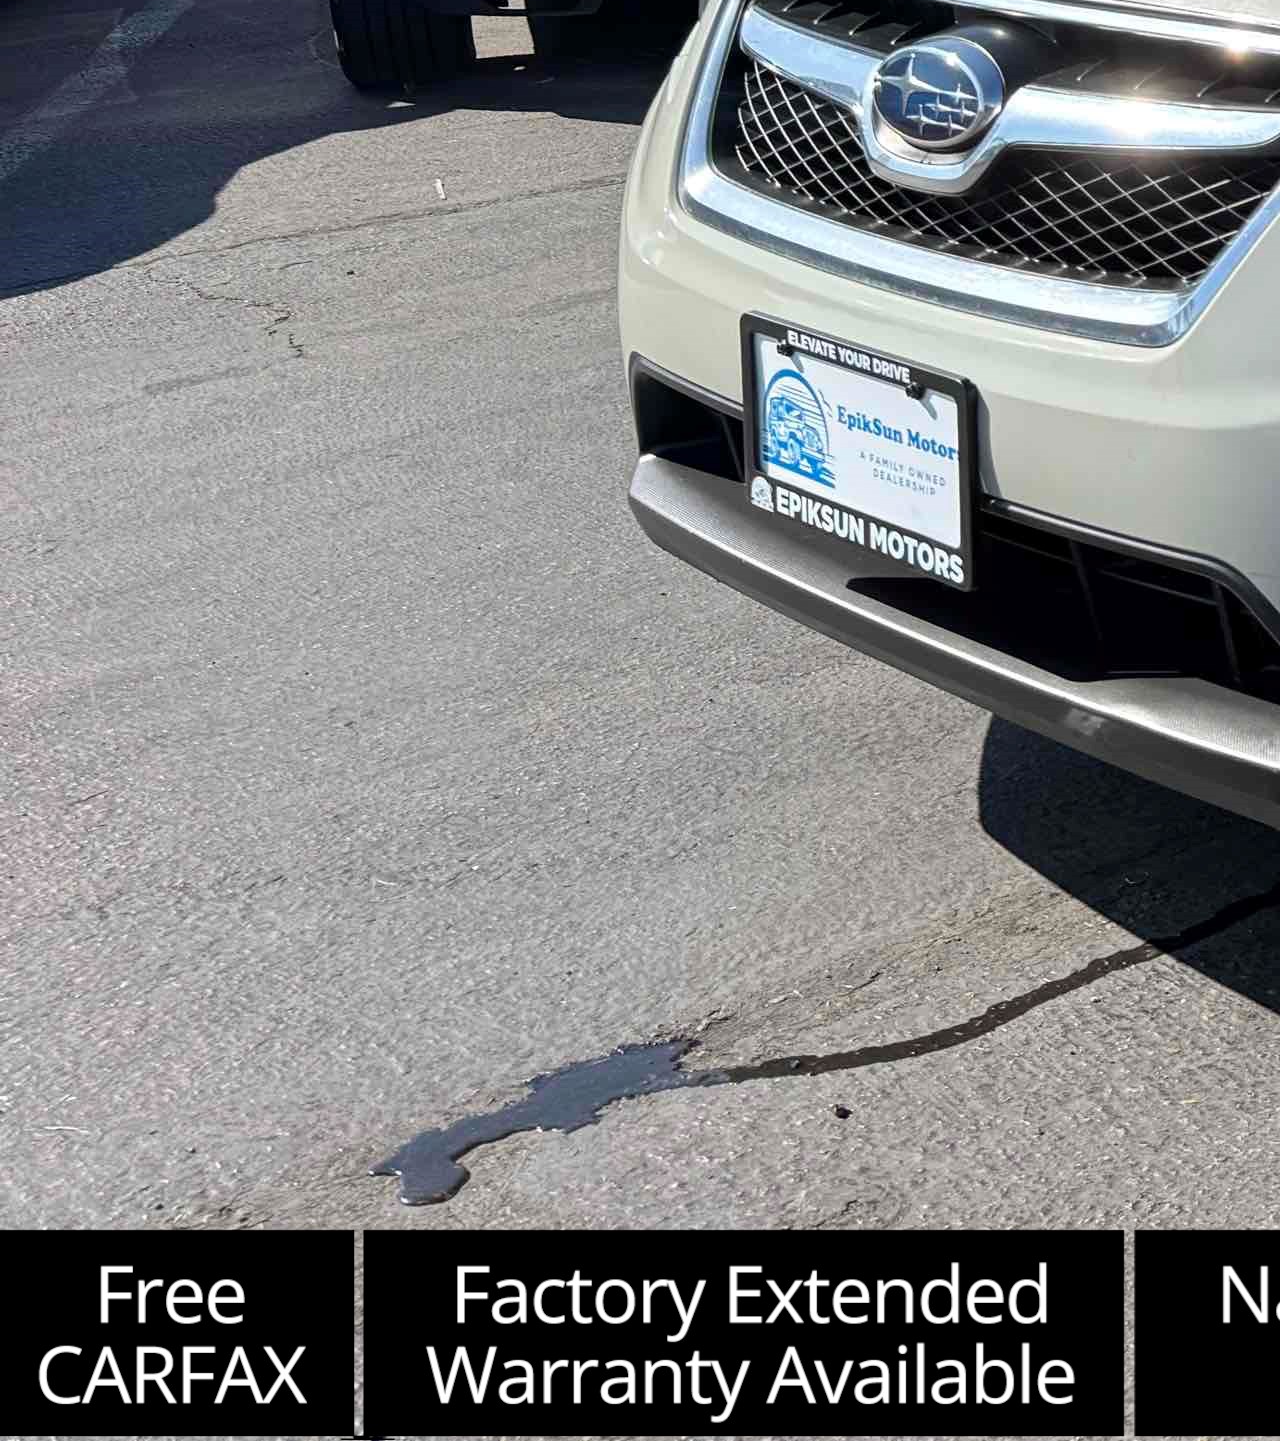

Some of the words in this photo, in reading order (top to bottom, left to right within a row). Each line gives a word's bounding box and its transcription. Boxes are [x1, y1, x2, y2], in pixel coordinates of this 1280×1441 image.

[787, 330, 837, 361] ELEVATE
[838, 347, 871, 371] YOUR
[872, 360, 911, 383] DRIVE
[837, 404, 903, 444] EpikSun
[907, 428, 960, 461] Motor
[870, 453, 904, 473] FAMILY
[908, 466, 946, 487] OWNED
[872, 467, 937, 496] DEALERSHIP
[776, 486, 866, 547] EPIKSUN
[870, 522, 964, 584] MOTORS
